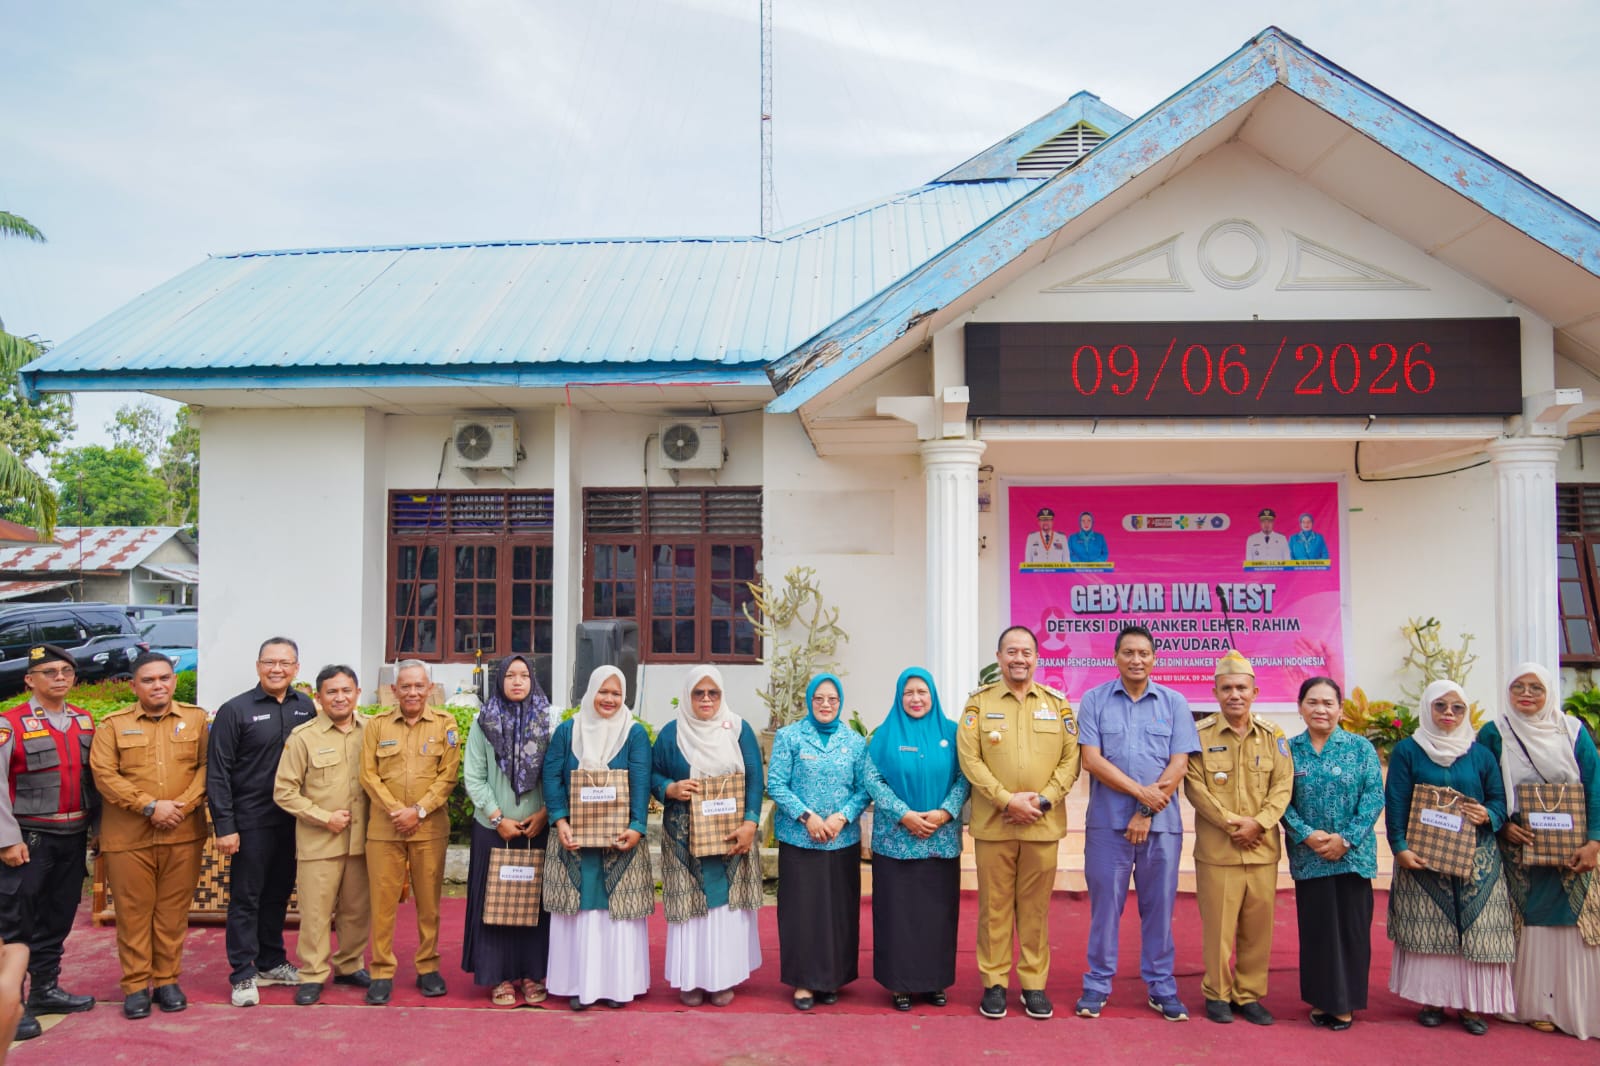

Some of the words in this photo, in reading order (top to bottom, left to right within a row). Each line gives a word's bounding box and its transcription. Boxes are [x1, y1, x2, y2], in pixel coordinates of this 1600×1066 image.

[1071, 336, 1437, 401] 09/06/2026
[1070, 583, 1166, 614] GEBYAR
[1172, 582, 1213, 613] IVA
[1217, 582, 1277, 613] TEST
[1047, 619, 1105, 632] DETEKSI
[1141, 619, 1198, 632] KANKER
[1202, 619, 1249, 633] LEHER,
[1252, 618, 1301, 632] RAHIM
[1154, 638, 1231, 651] PAYUDARA
[1037, 657, 1066, 667] ERAKAN
[1168, 657, 1183, 667] DINI
[1184, 657, 1214, 667] KANKER
[1284, 655, 1326, 666] INDONESIA
